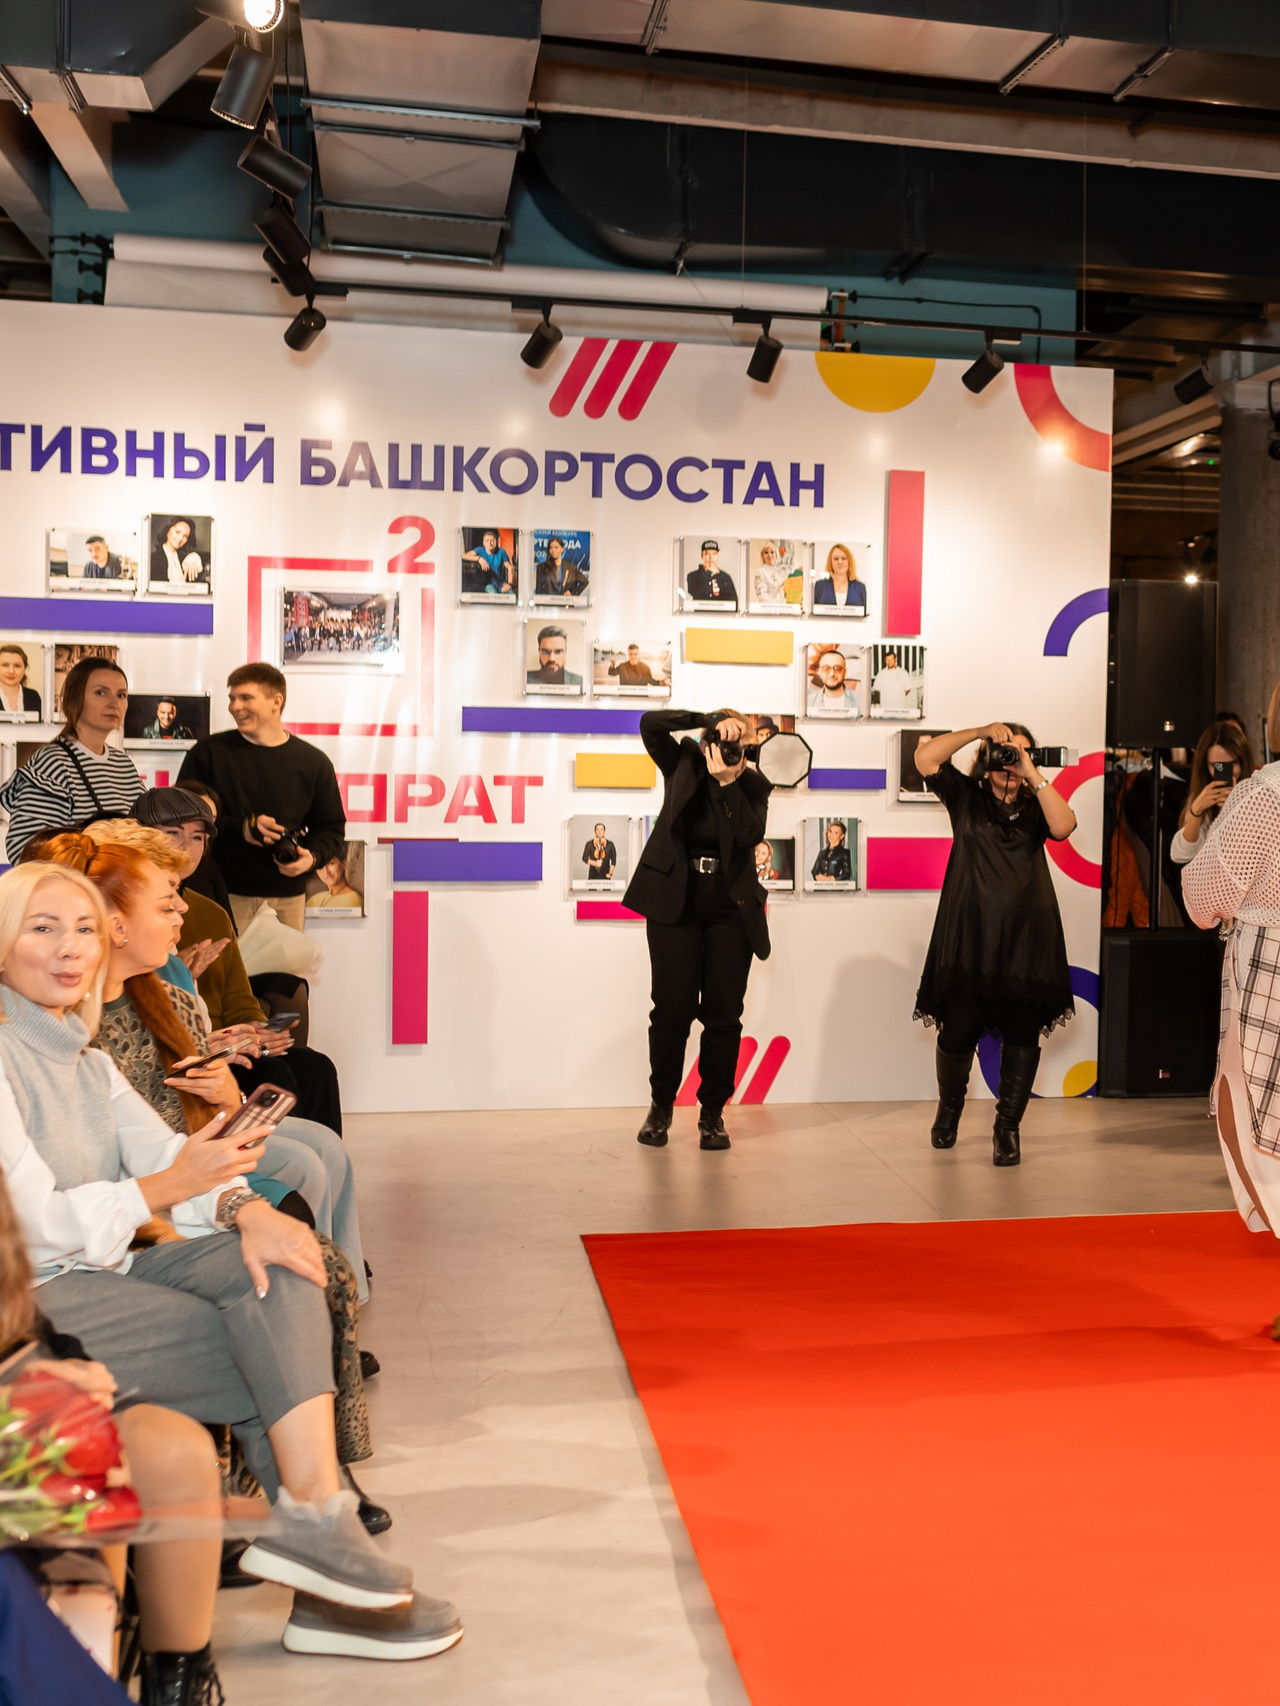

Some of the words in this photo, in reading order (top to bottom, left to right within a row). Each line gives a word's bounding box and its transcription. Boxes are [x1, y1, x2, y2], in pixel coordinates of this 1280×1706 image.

[0, 423, 275, 484] ТИВНЫЙ
[300, 438, 826, 508] БАШКОРТОСТАН
[387, 515, 435, 575] 2
